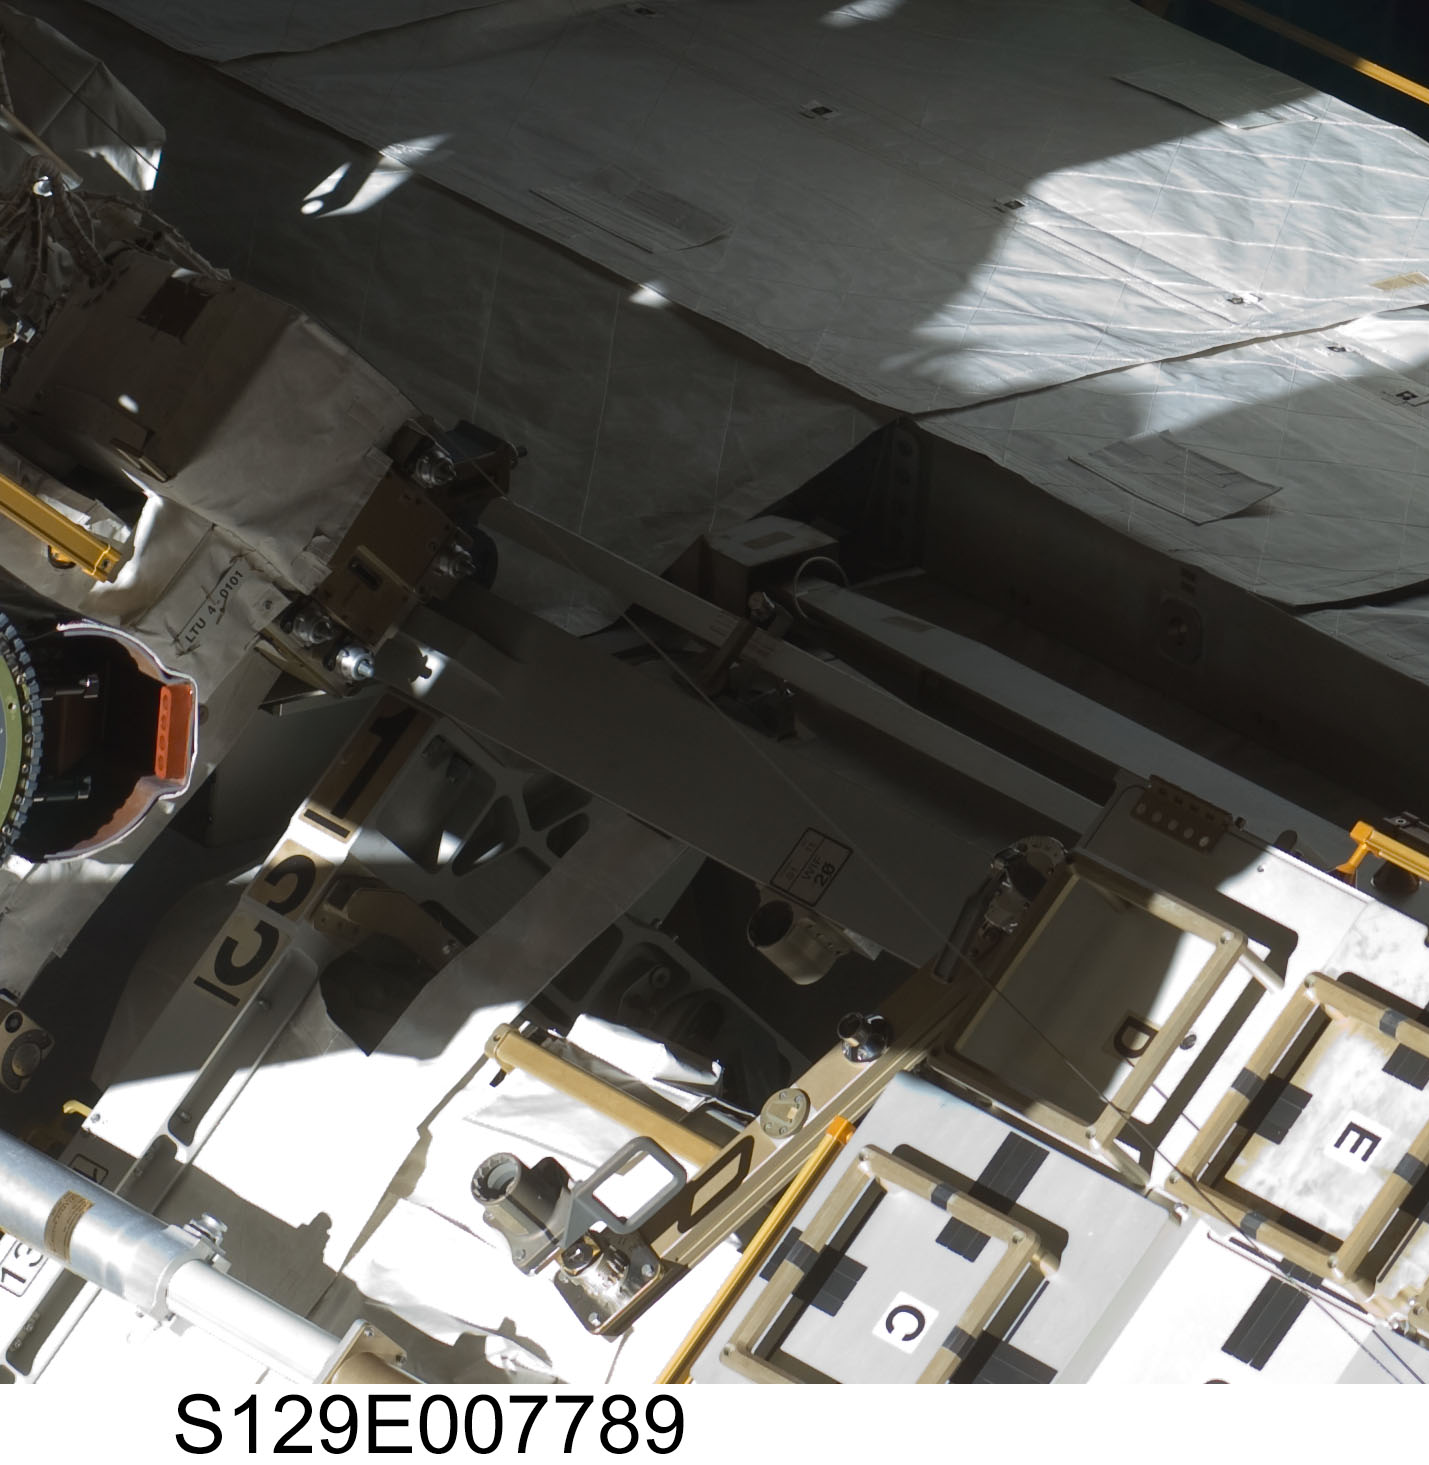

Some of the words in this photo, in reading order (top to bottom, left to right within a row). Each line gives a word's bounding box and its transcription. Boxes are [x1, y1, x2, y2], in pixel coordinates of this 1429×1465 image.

[185, 617, 206, 644] LTU
[1113, 1015, 1159, 1059] D
[1333, 1120, 1382, 1163] E
[885, 1304, 926, 1342] C
